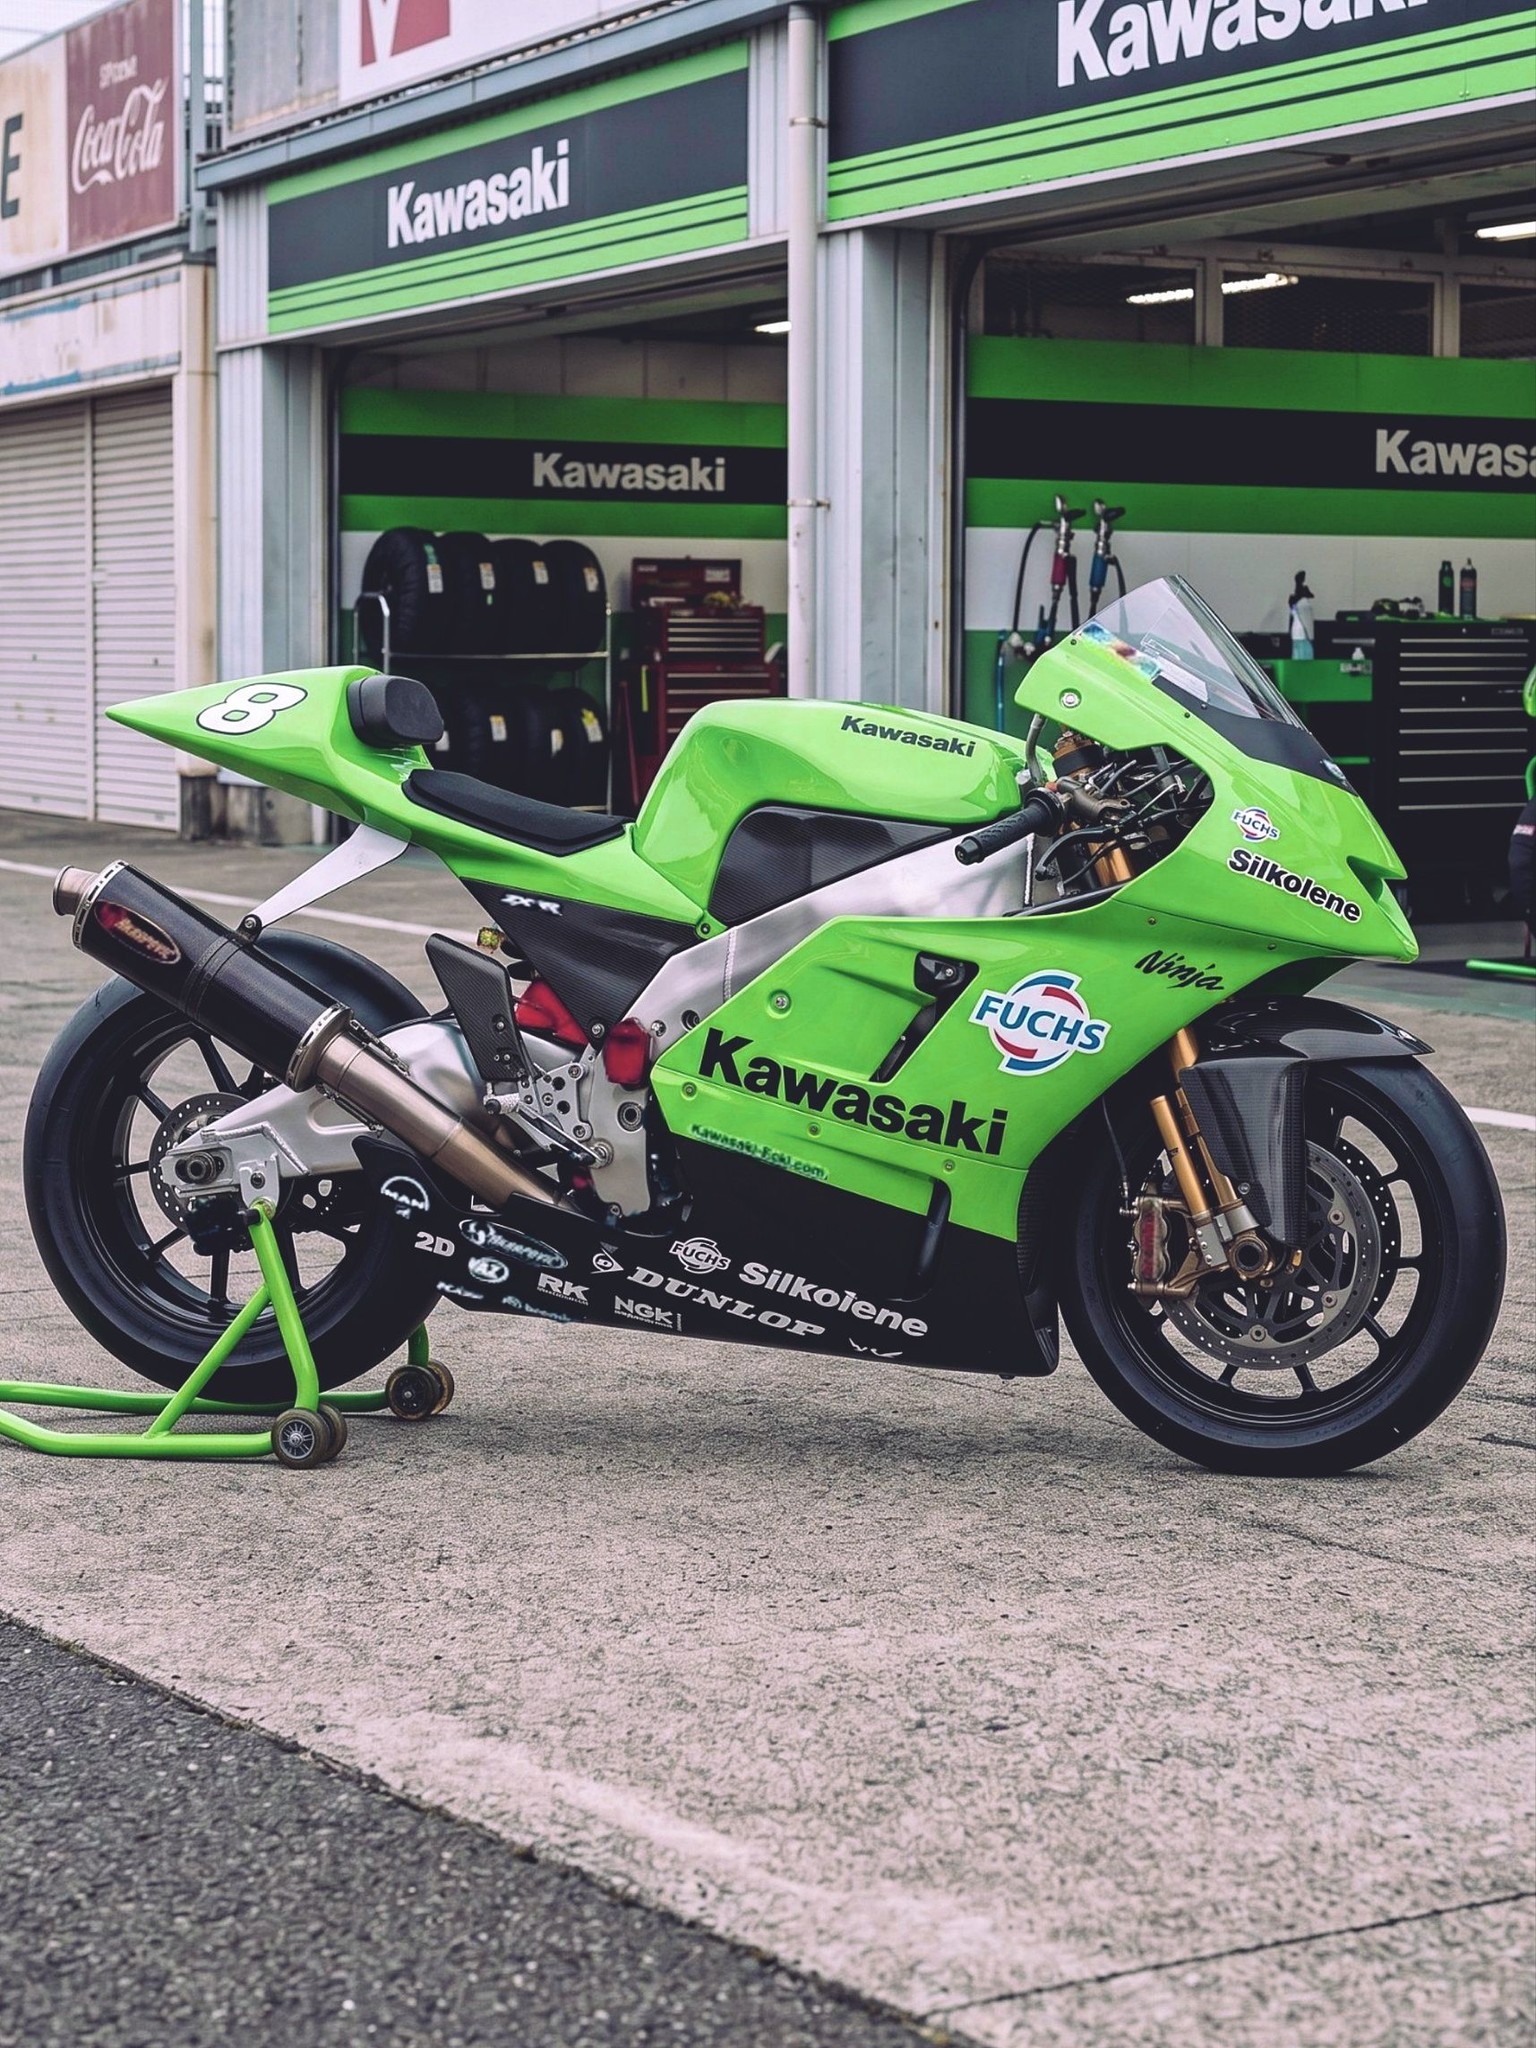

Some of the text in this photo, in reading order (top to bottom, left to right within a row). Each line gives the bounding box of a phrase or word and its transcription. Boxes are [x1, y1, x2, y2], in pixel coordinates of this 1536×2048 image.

[1057, 0, 1428, 88] Kawasa
[387, 139, 570, 248] Kawasaki
[532, 451, 726, 493] Kawasaki
[196, 682, 308, 736] 8
[841, 715, 976, 758] Kawasaki
[1233, 811, 1279, 839] FUCHS
[1228, 848, 1361, 922] Silkolene
[1134, 949, 1225, 992] Ninja
[974, 993, 1105, 1051] FUCHS
[699, 1027, 1008, 1156] Kawasaki
[414, 1231, 456, 1258] 2D
[670, 1242, 730, 1270] FUCHS
[538, 1272, 590, 1302] RK
[626, 1266, 826, 1337] DUNLOP
[614, 1295, 673, 1325] NGK
